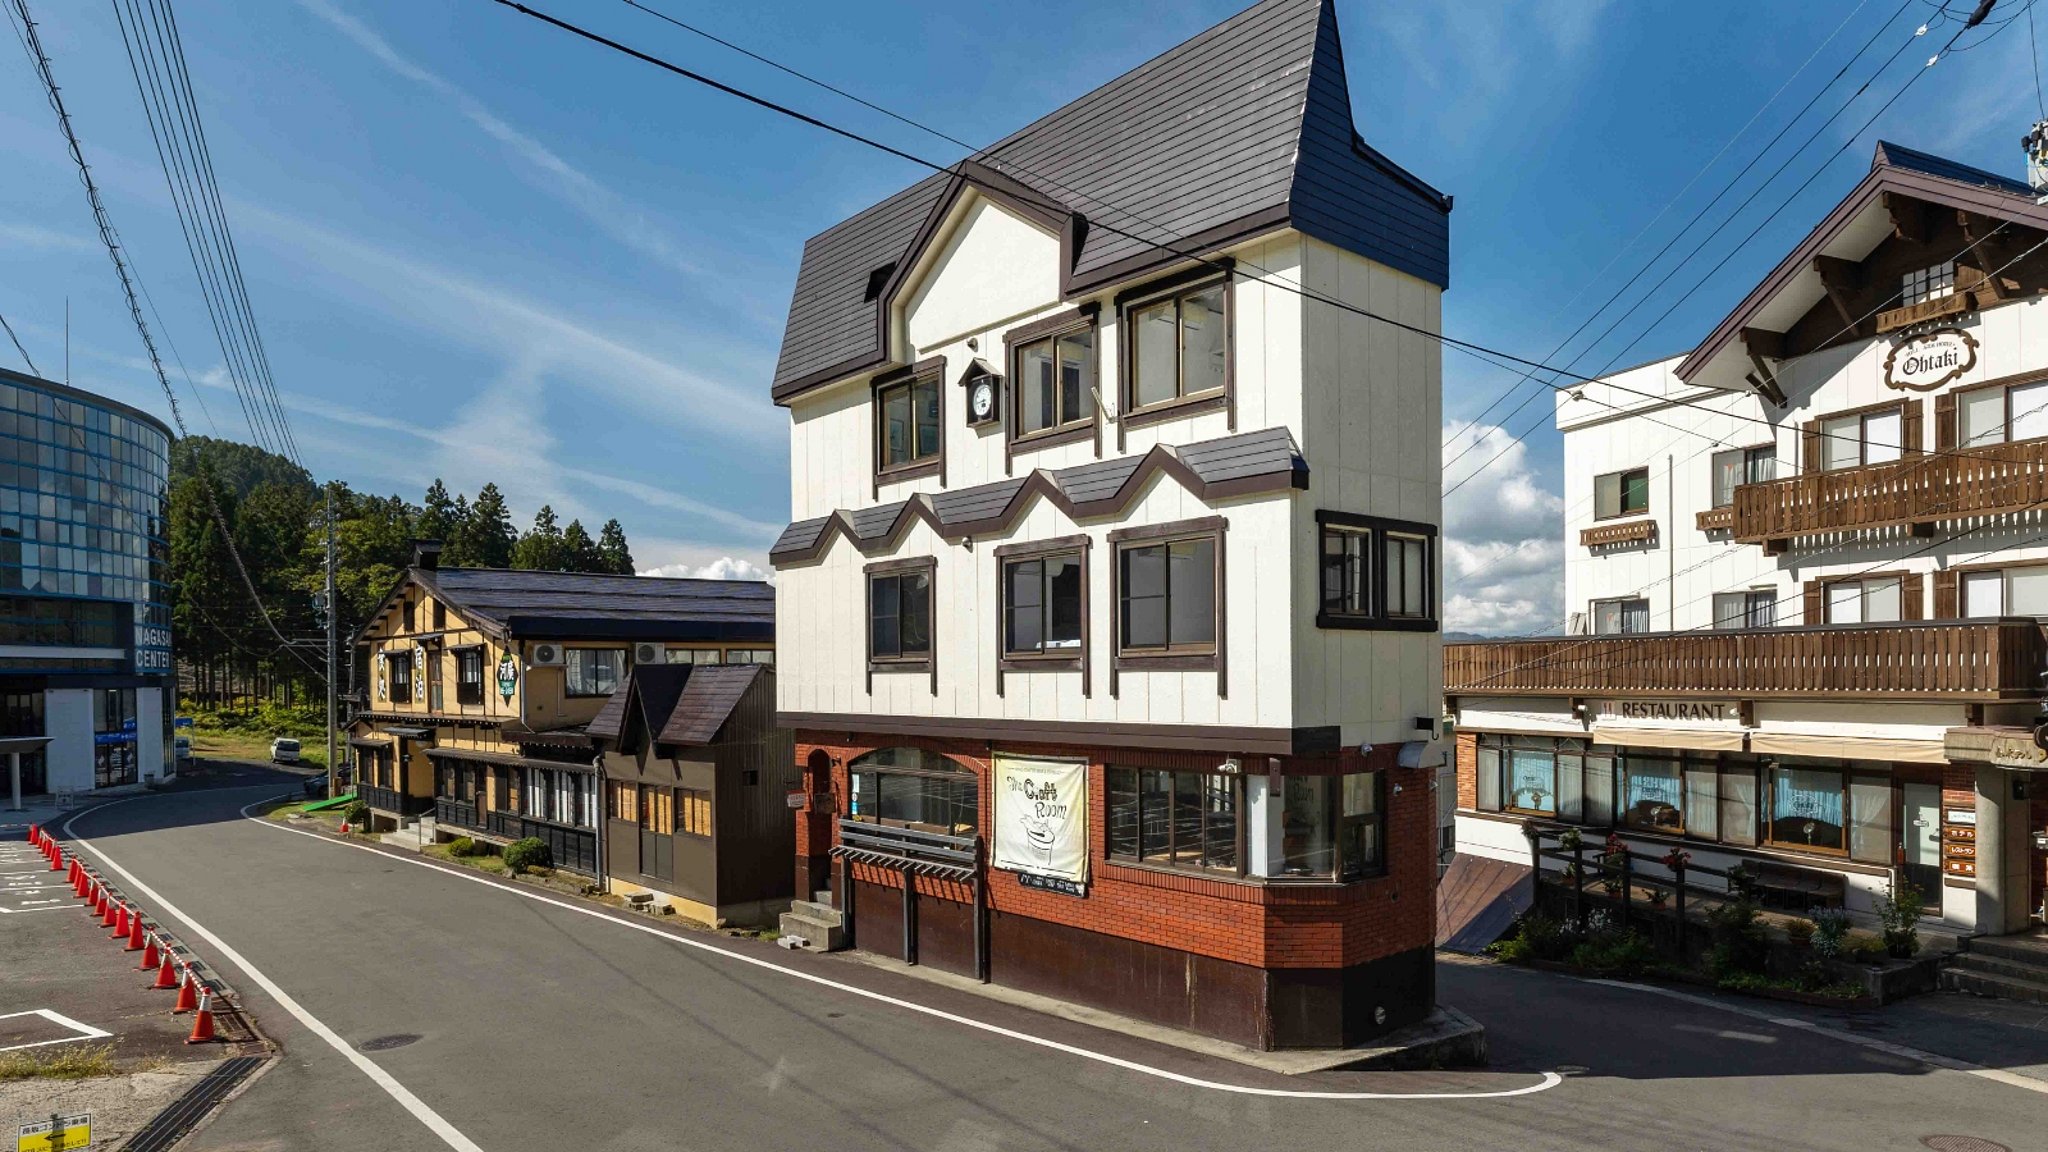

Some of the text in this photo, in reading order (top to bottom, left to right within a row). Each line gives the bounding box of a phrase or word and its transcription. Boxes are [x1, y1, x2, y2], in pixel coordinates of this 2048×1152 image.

[1903, 347, 1958, 375] Ohtaki
[136, 650, 169, 667] CENTER
[1622, 702, 1725, 720] RESTAURANT
[1951, 830, 1974, 838] ホテル
[1951, 846, 1975, 855] レストラン
